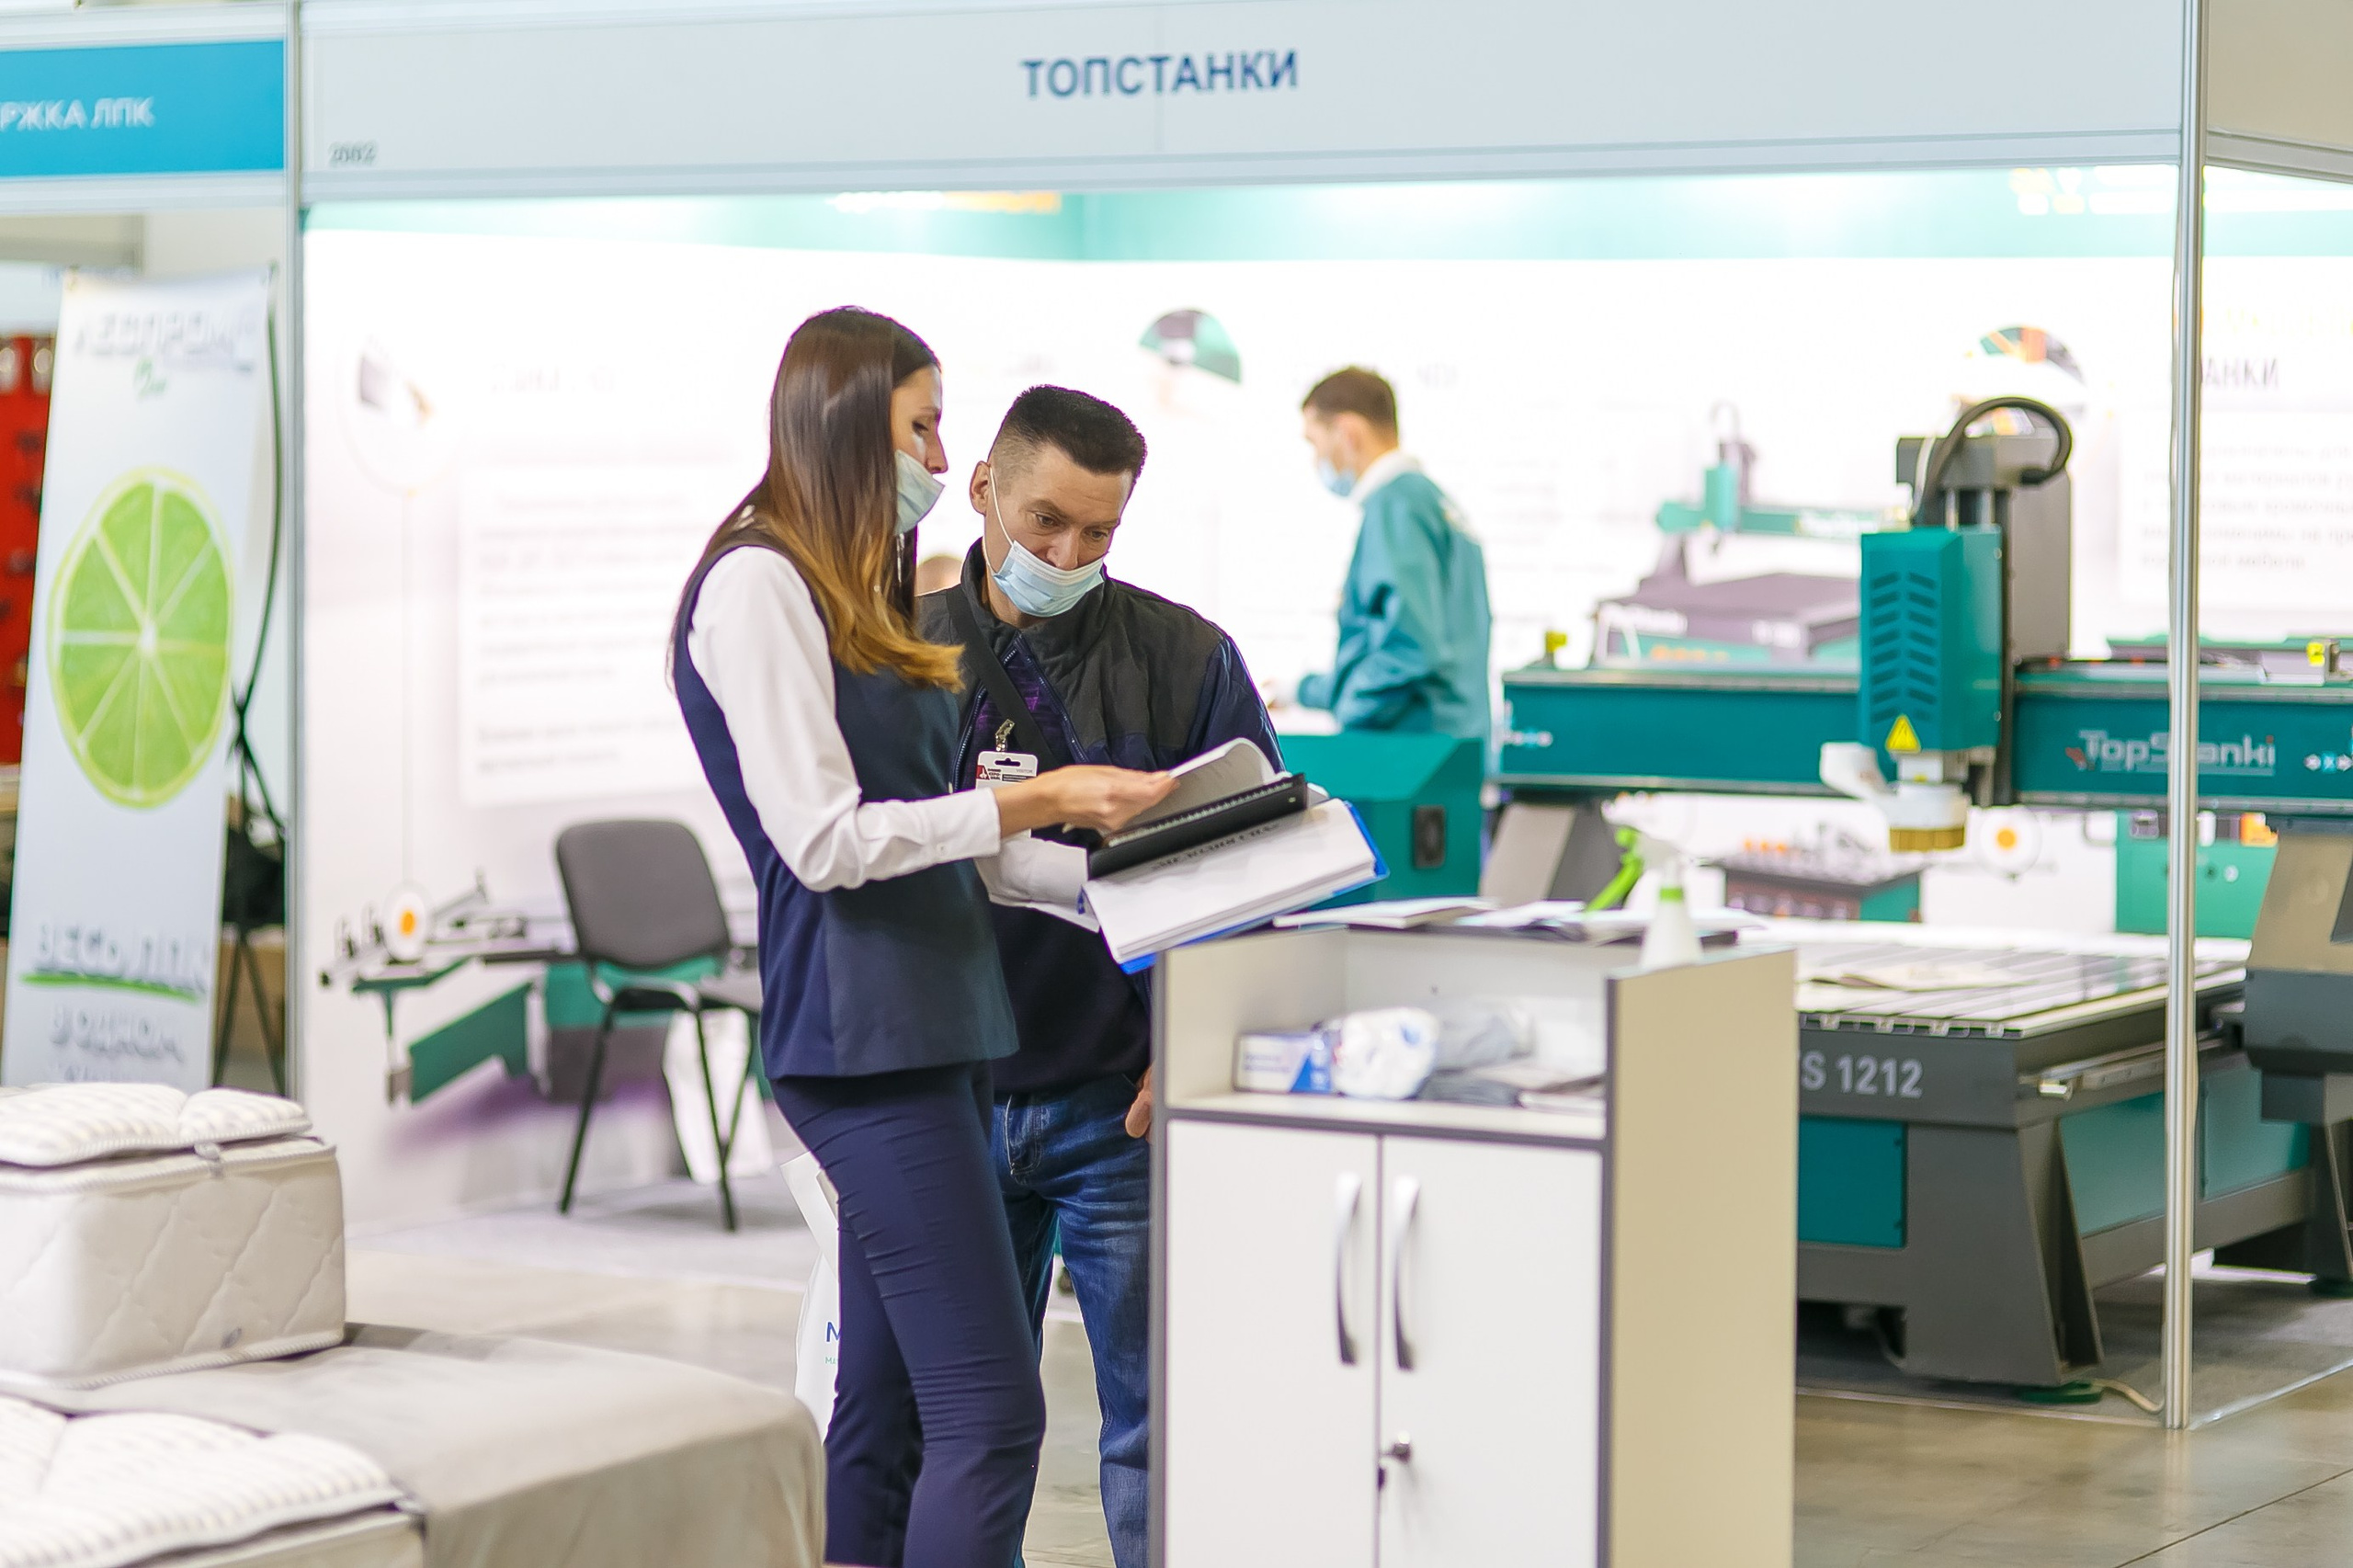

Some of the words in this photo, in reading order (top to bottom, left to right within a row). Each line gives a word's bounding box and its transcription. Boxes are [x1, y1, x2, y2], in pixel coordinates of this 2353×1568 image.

[1019, 49, 1299, 98] ТОПСТАНКИ
[0, 100, 89, 131] РЖКА
[90, 97, 154, 129] ЛПК
[2077, 730, 2276, 770] TopSanki
[1802, 1051, 1826, 1091] S
[1836, 1054, 1923, 1099] 1212
